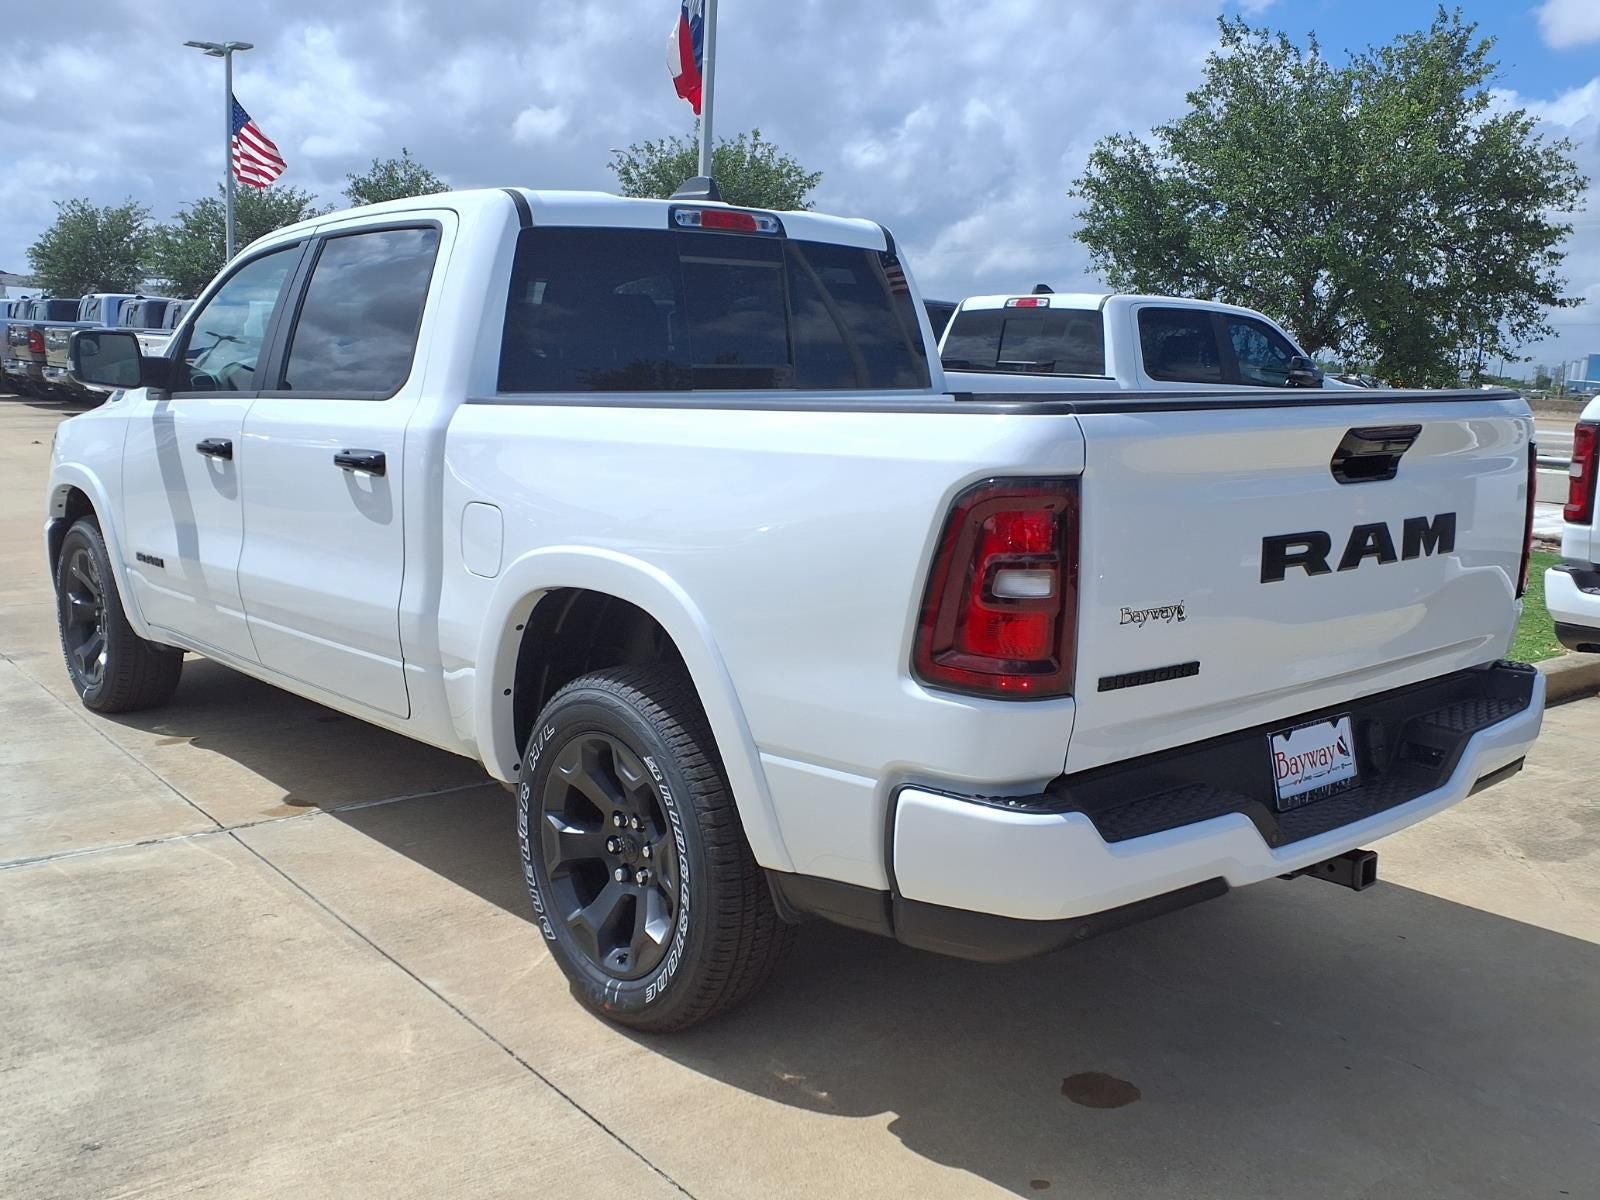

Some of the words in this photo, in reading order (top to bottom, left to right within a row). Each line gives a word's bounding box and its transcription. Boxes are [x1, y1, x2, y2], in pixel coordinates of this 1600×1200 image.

[1260, 512, 1456, 584] RAM
[1120, 604, 1177, 628] Bayway
[1275, 744, 1336, 784] Bayway
[643, 756, 690, 1004] BRIDGESTONE
